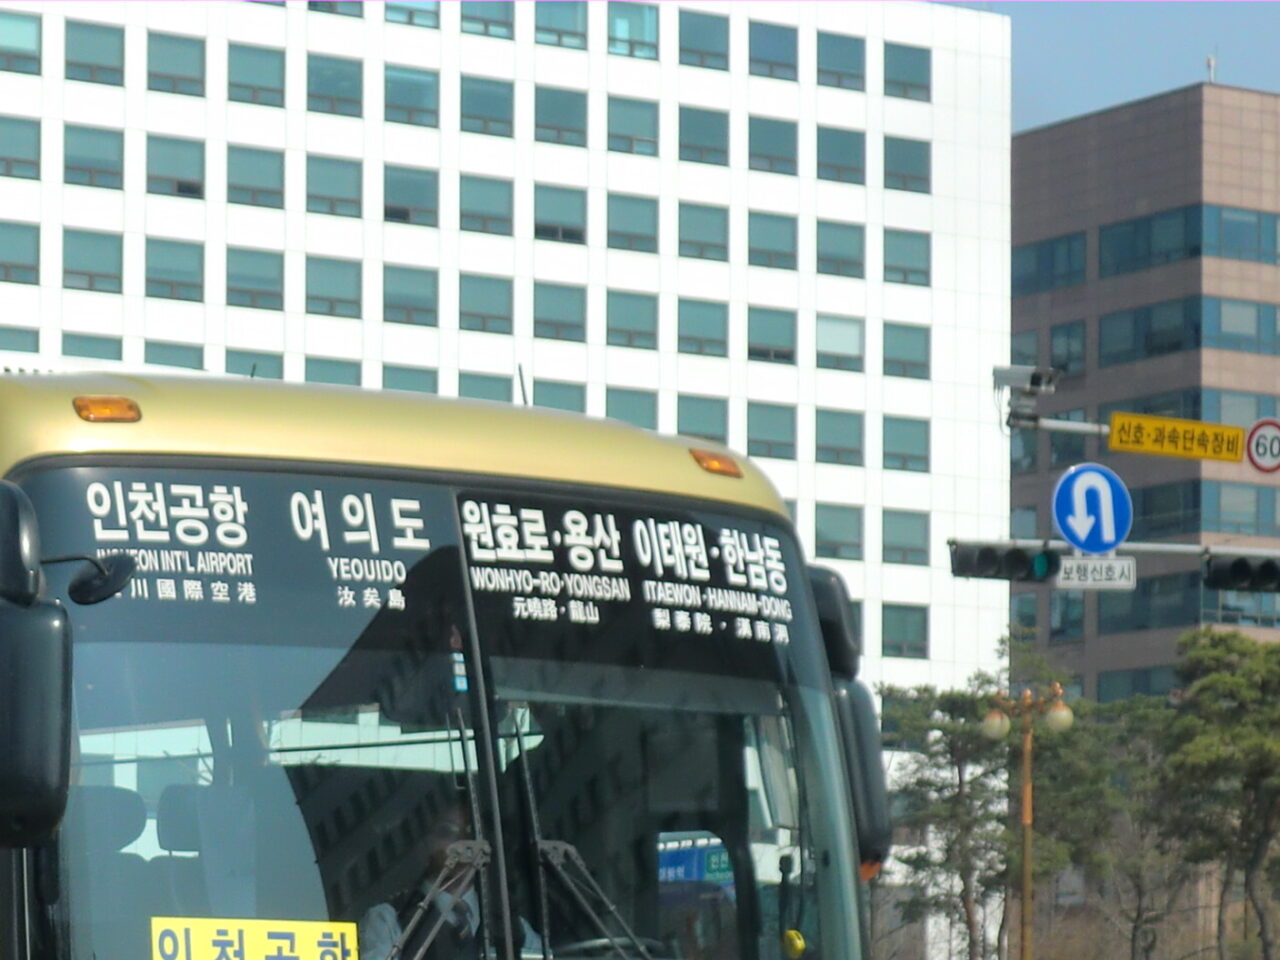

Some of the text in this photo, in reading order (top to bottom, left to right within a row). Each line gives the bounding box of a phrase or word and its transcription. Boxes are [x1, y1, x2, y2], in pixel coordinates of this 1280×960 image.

[1255, 434, 1280, 459] 60
[86, 479, 250, 549] 인천공항
[160, 550, 195, 572] INT'L
[197, 551, 254, 576] AIRPORT
[327, 556, 407, 584] YEOUIDO
